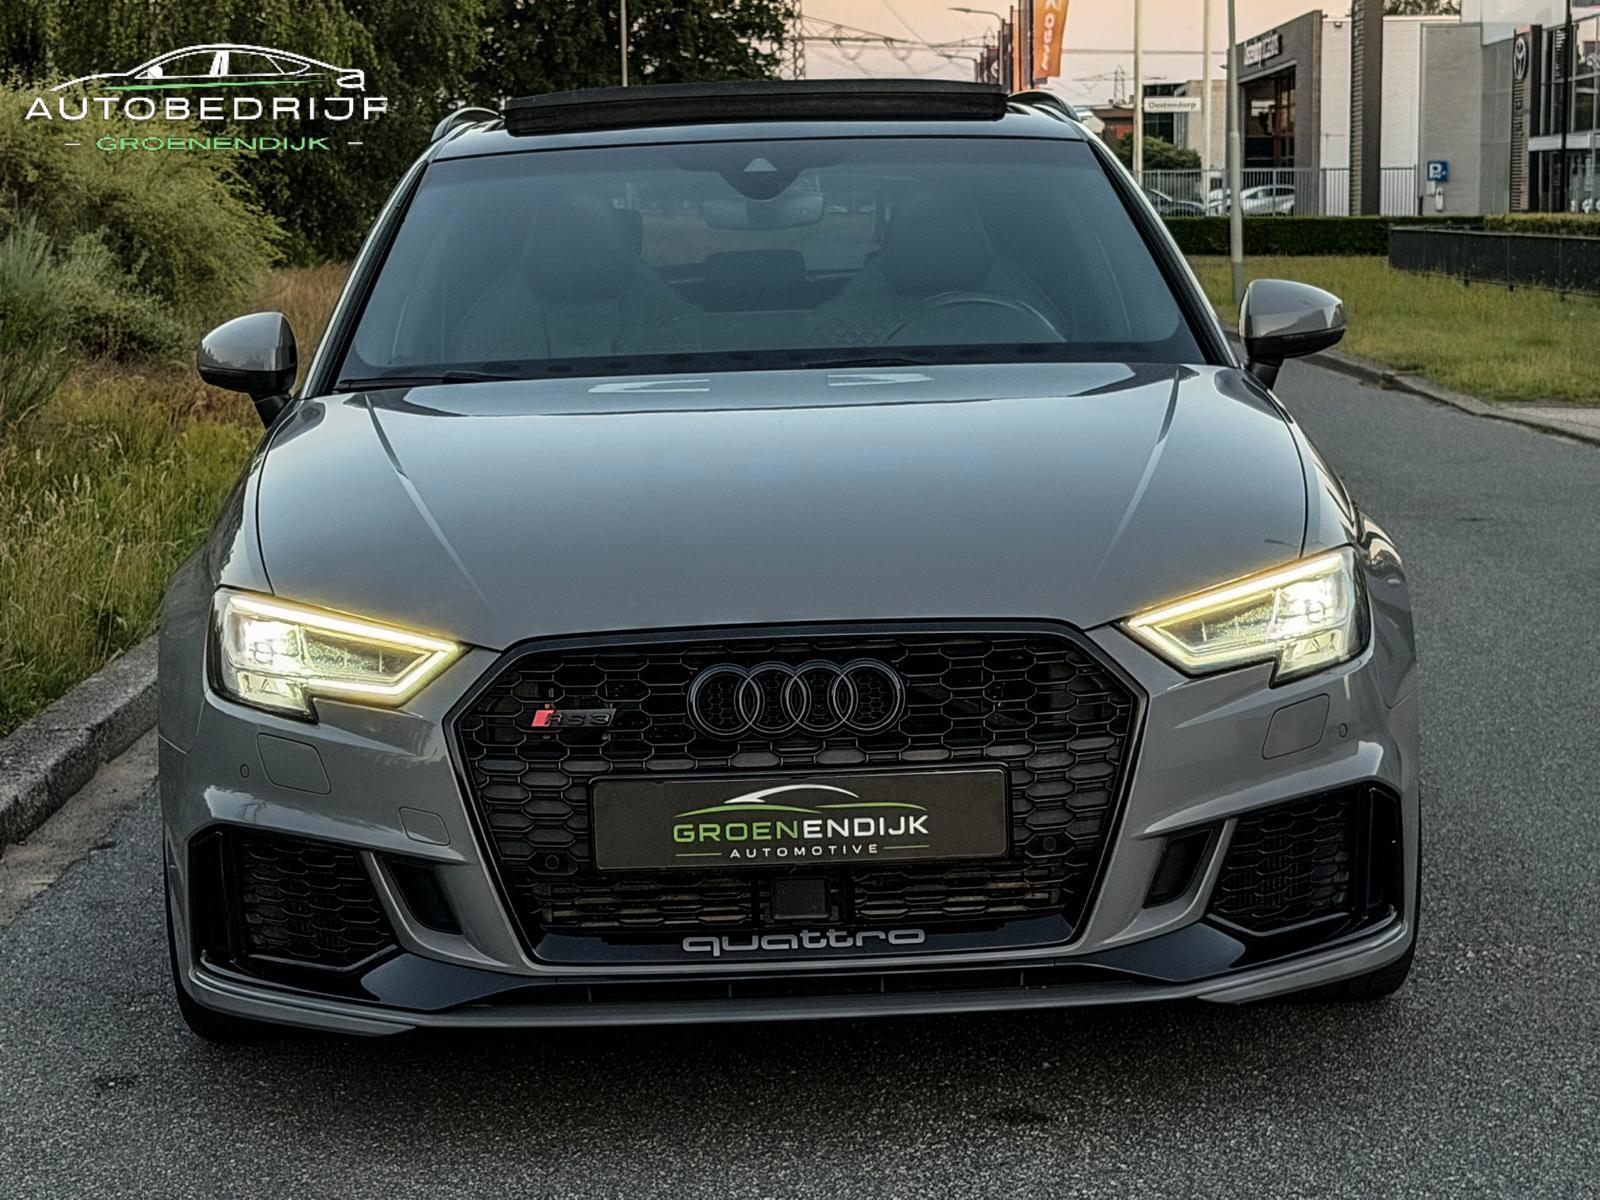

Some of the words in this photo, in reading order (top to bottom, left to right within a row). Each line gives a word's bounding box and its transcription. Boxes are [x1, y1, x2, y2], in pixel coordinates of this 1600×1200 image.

[672, 815, 929, 843] GROENENDIJK
[729, 843, 878, 859] AUTOMOTIVE
[682, 928, 926, 957] quattro
